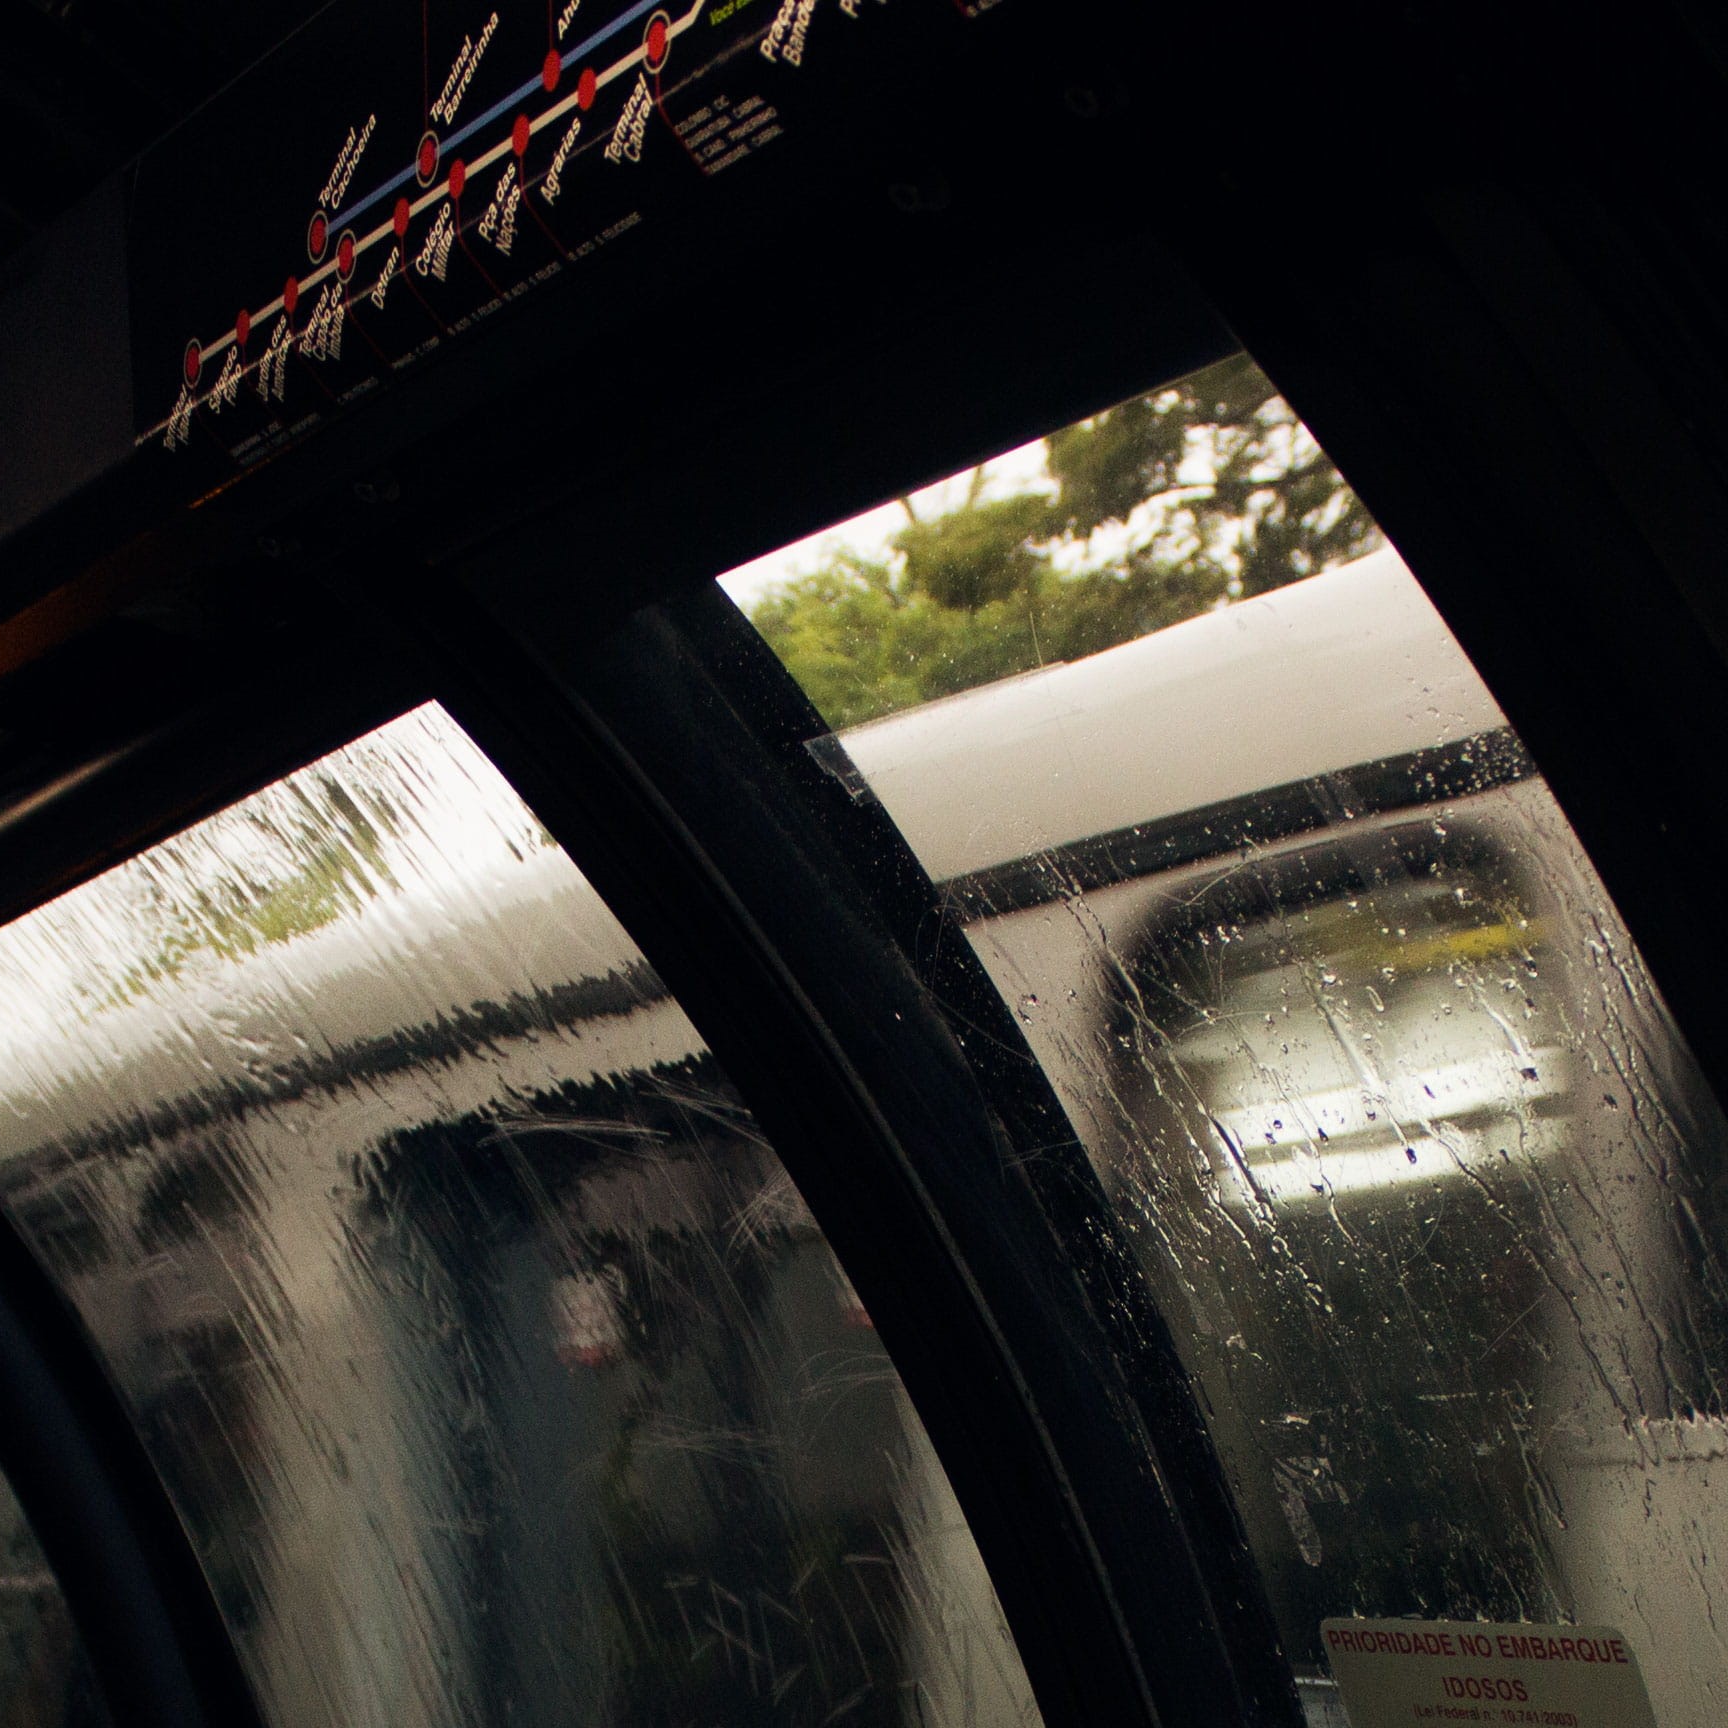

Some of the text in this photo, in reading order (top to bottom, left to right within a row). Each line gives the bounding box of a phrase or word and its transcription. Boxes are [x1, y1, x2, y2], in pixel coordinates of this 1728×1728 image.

[430, 33, 473, 123] Terminal
[444, 11, 500, 126] Barreirinha
[603, 71, 647, 165] Terminal
[623, 86, 655, 163] Cabral
[318, 126, 357, 208] Terminal
[330, 112, 377, 210] Cachoeira
[495, 161, 517, 202] das
[414, 202, 452, 277] Colégio
[431, 219, 457, 283] Militar
[371, 245, 400, 311] Detran
[299, 284, 330, 359] Terminal
[209, 345, 238, 415] Salgado
[1327, 1629, 1629, 1664] PRIORIDADE NO EMBARQUE
[1437, 1704, 1480, 1722] Federal
[1441, 1676, 1529, 1702] IDOSOS
